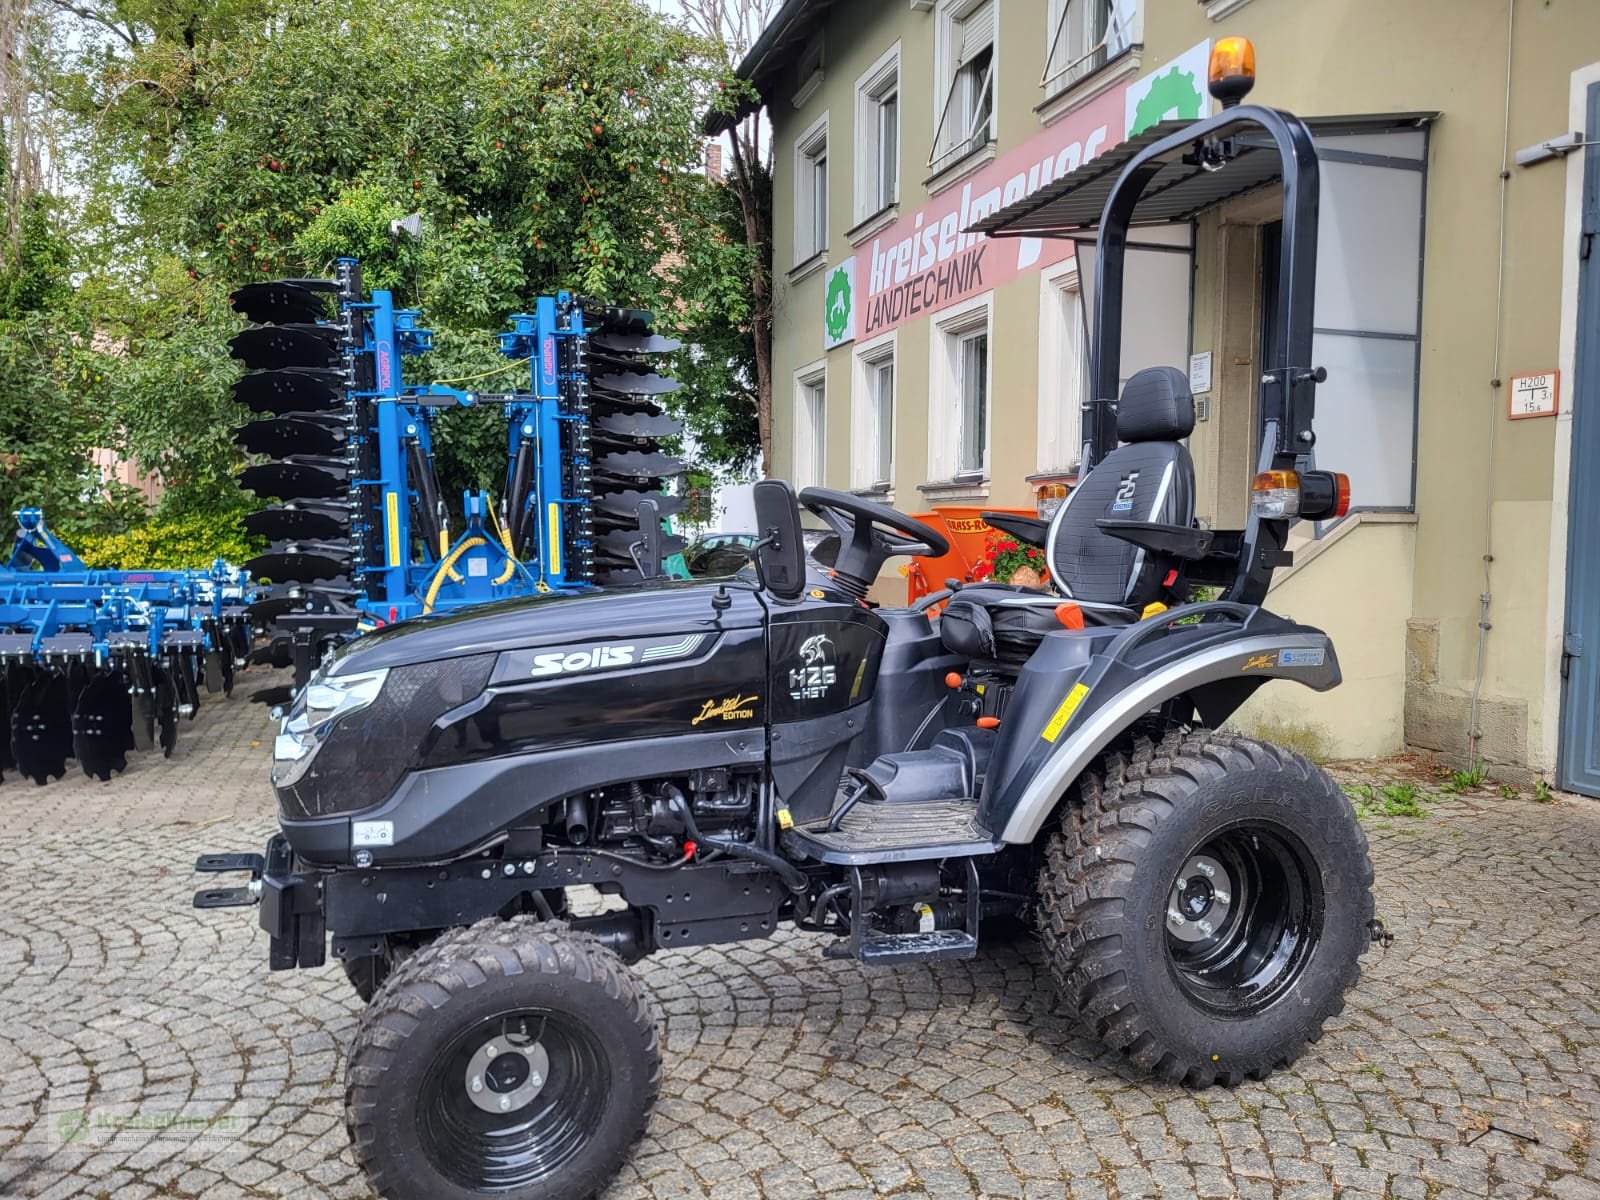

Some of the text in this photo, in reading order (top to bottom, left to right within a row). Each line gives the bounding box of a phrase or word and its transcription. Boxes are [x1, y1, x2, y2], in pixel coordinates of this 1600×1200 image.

[865, 245, 986, 333] LANDTECHNIK
[1520, 376, 1546, 388] H200
[802, 686, 828, 699] HST
[692, 694, 758, 726] Limited
[722, 709, 753, 721] EDITION
